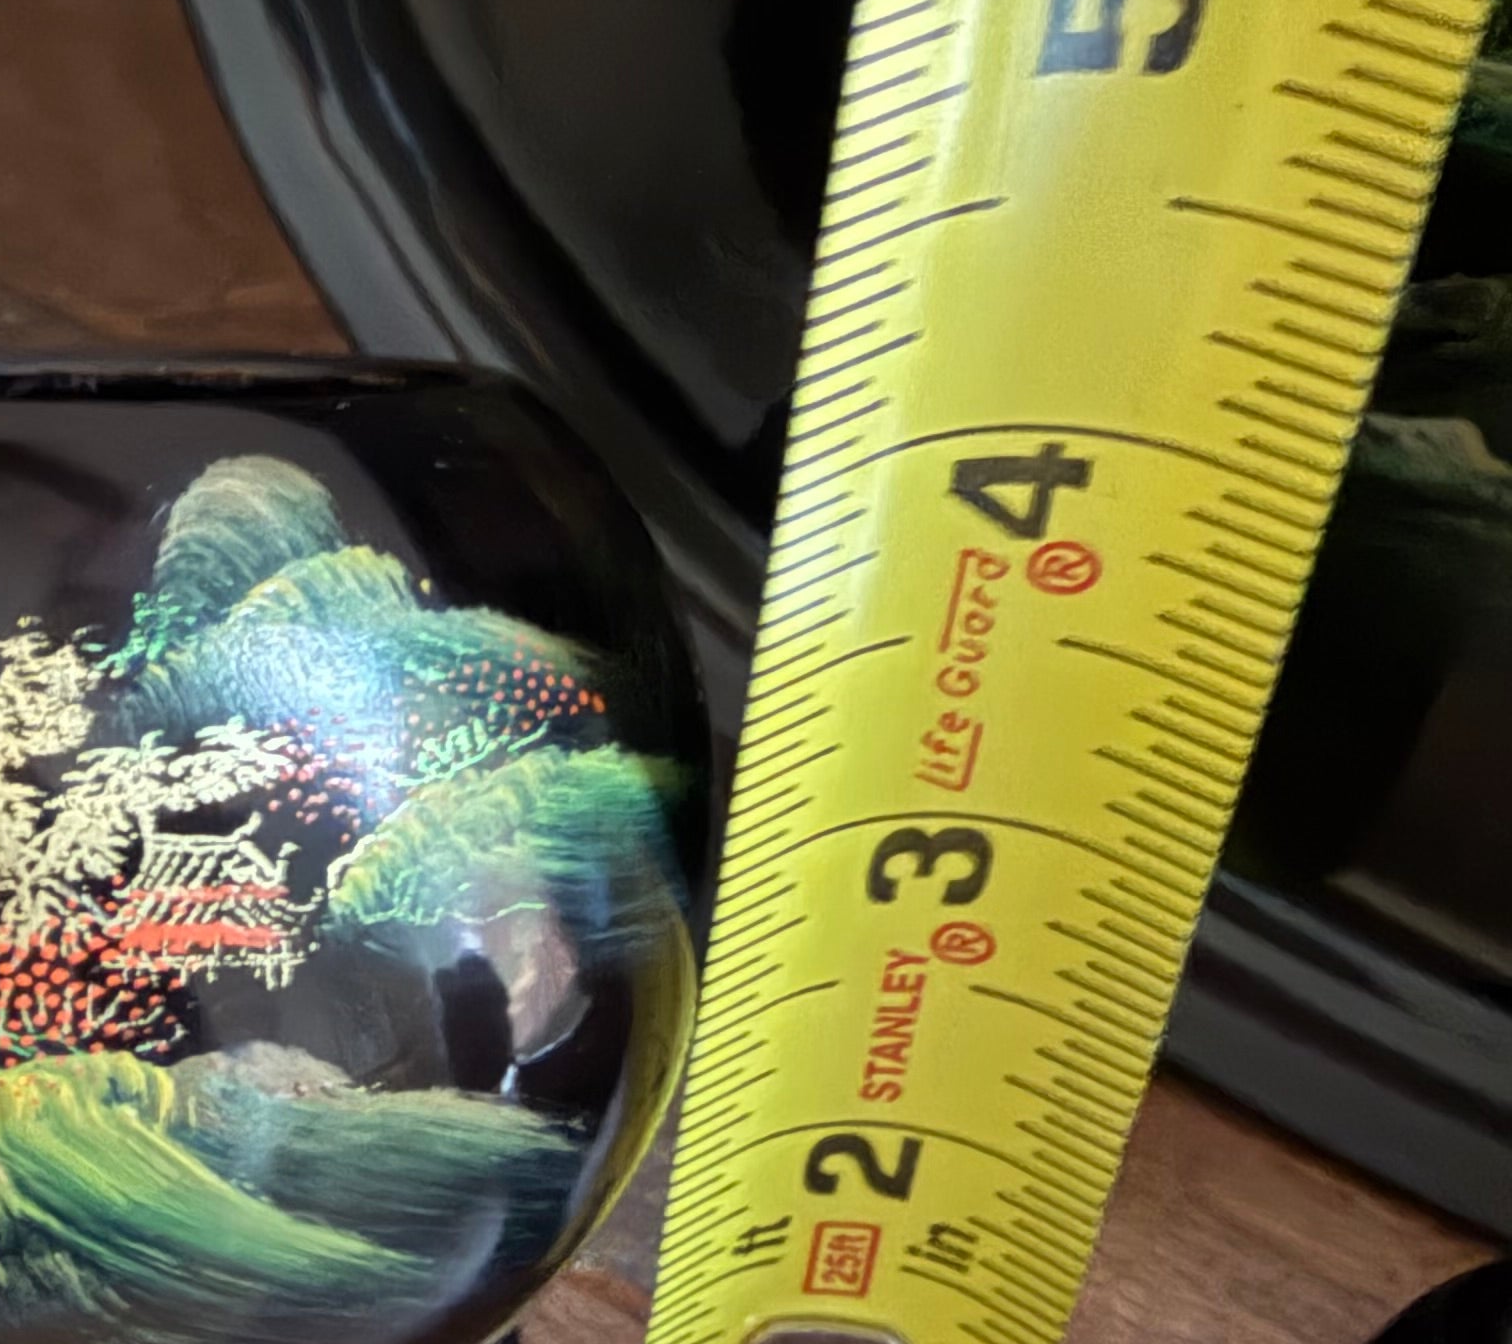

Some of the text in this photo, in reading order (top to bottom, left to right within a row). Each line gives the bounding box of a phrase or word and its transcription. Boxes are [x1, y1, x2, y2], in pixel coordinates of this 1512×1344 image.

[948, 442, 1094, 540] 4
[866, 826, 994, 905] 3
[858, 948, 931, 1103] STANLEY
[804, 1133, 923, 1202] 2
